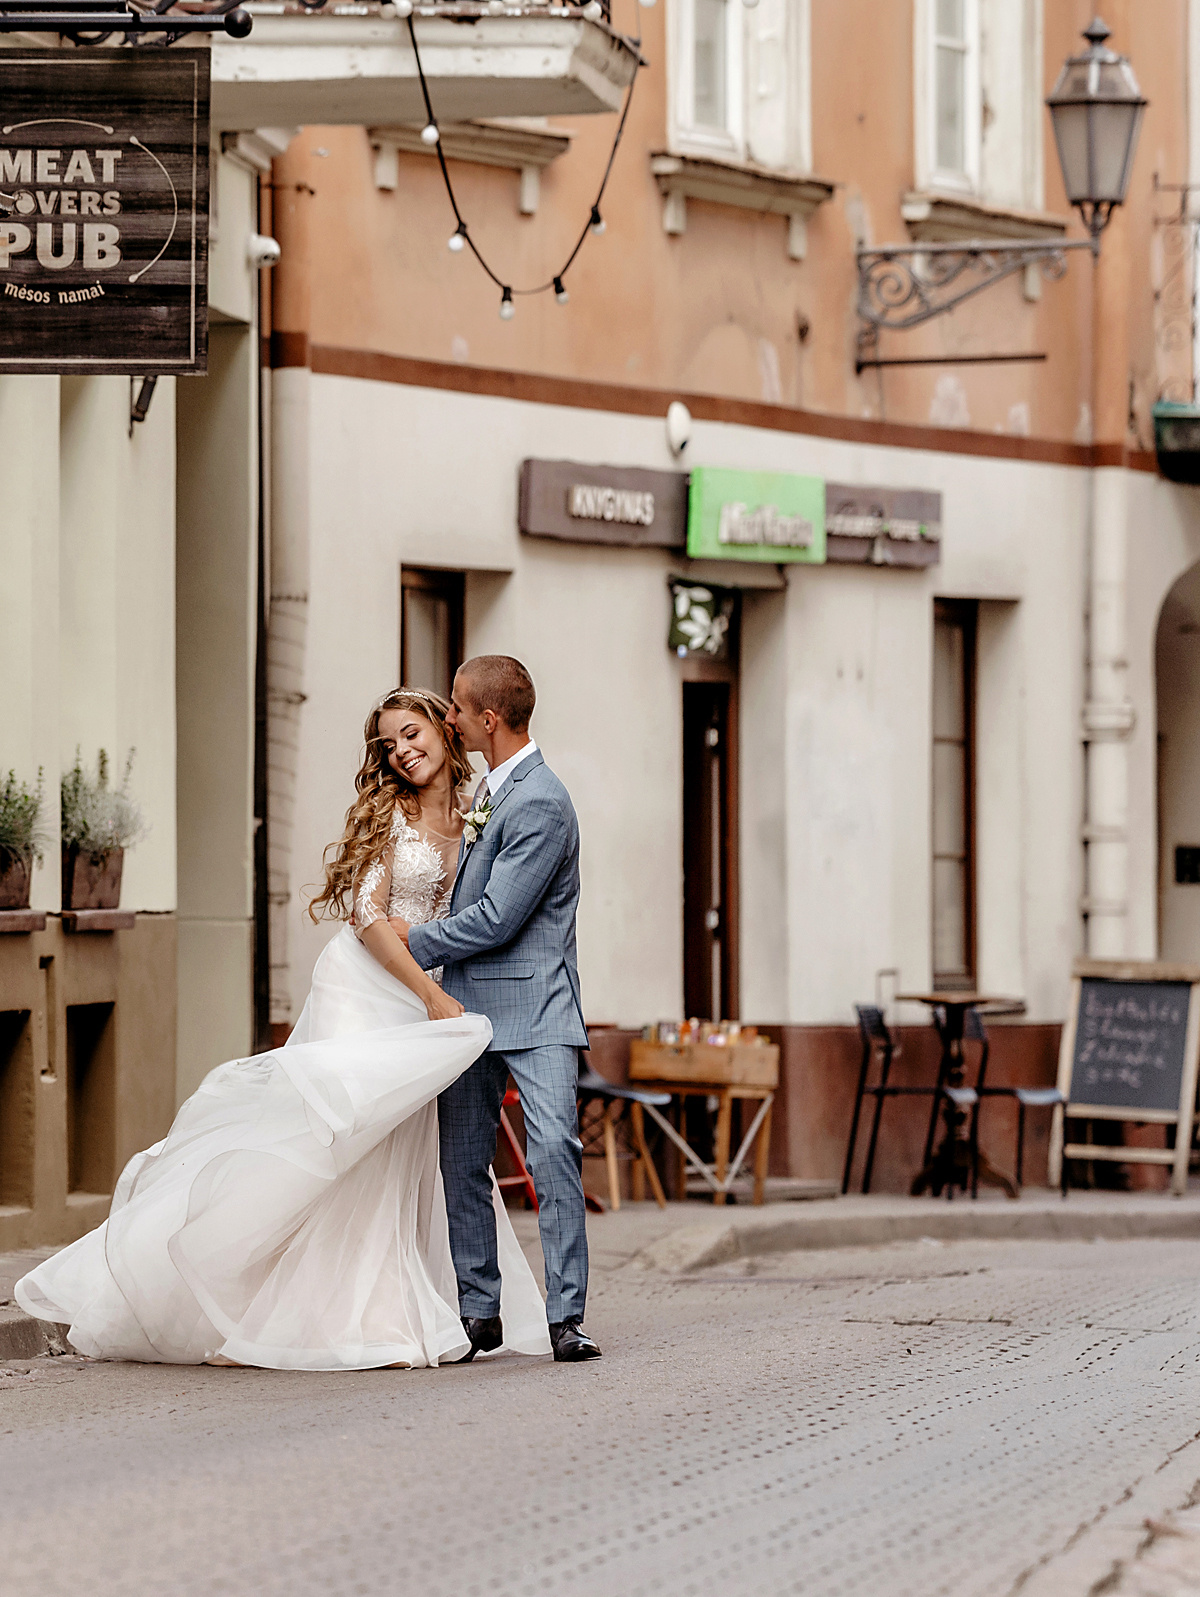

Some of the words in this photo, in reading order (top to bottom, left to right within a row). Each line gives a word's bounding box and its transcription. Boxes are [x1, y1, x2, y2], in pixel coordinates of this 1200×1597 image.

[8, 189, 123, 216] OVERS
[4, 282, 51, 305] mėsos
[57, 279, 106, 305] namai
[571, 484, 656, 527] KNYGYNAS
